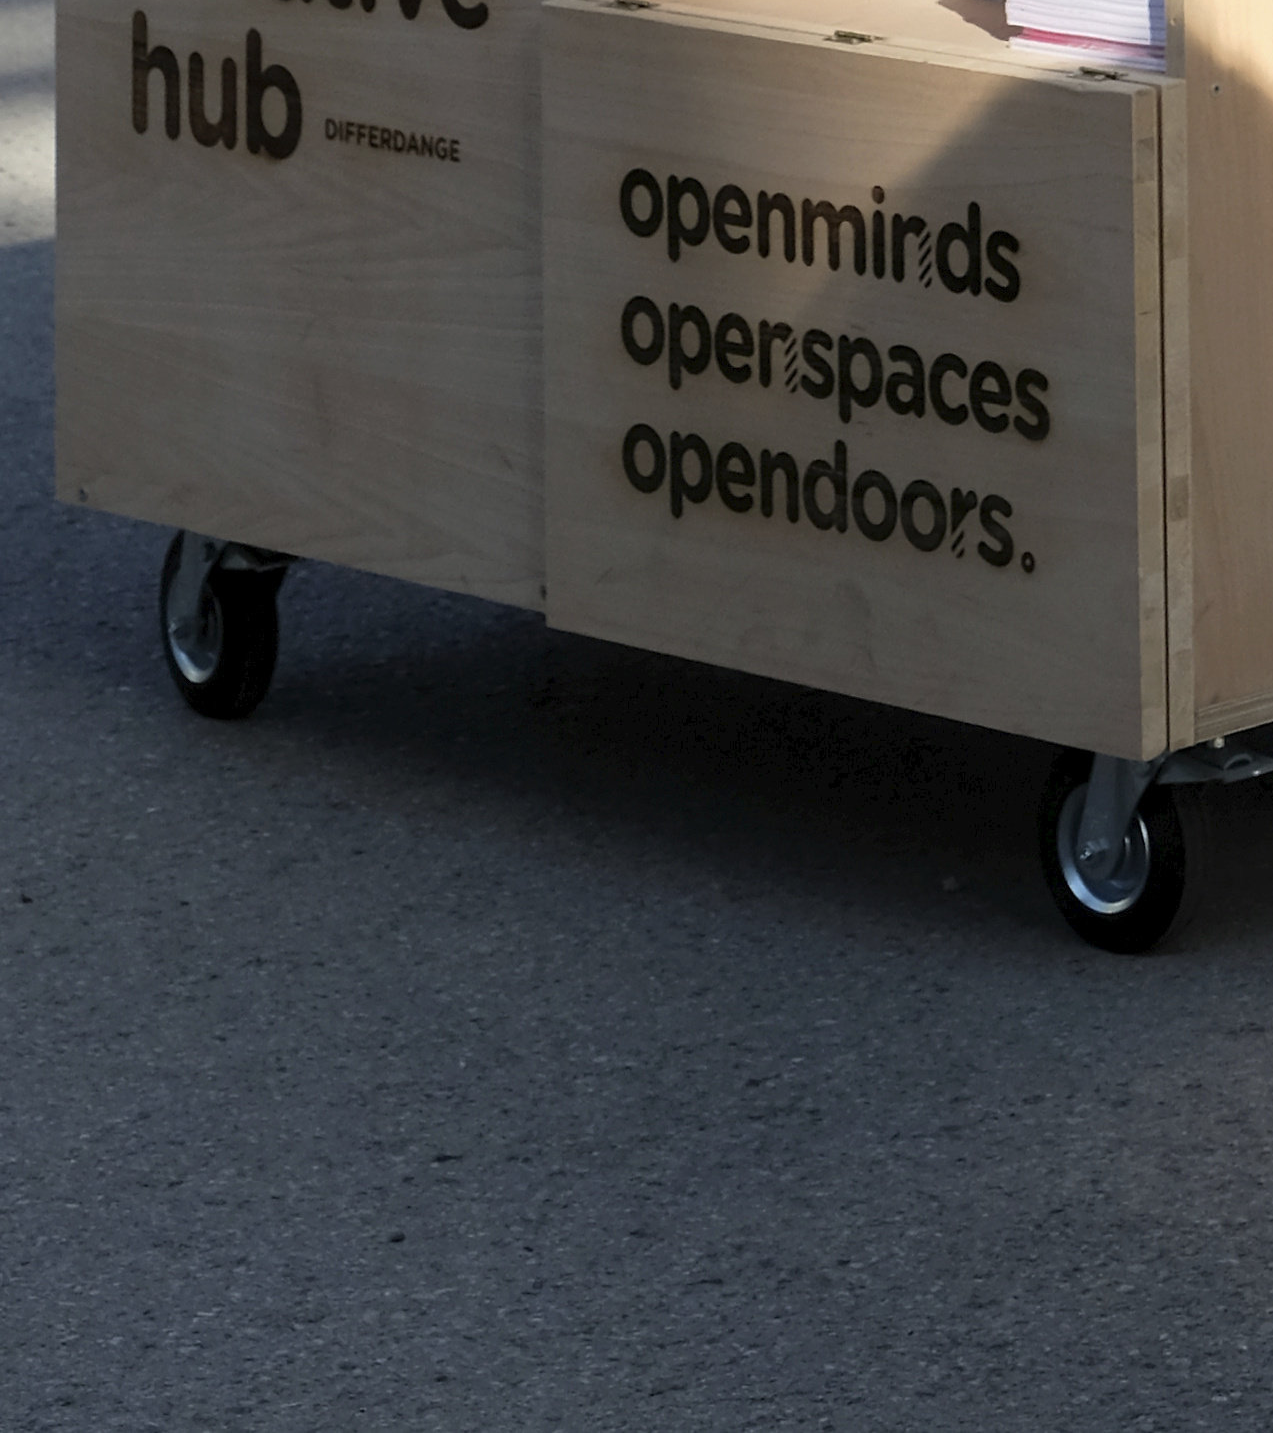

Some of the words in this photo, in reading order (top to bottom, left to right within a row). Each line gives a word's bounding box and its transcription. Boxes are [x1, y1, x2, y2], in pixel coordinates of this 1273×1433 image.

[131, 10, 303, 161] hub
[324, 116, 461, 164] DIFFERDANGE
[619, 167, 1021, 304] openminds
[620, 295, 1052, 442] openspaces
